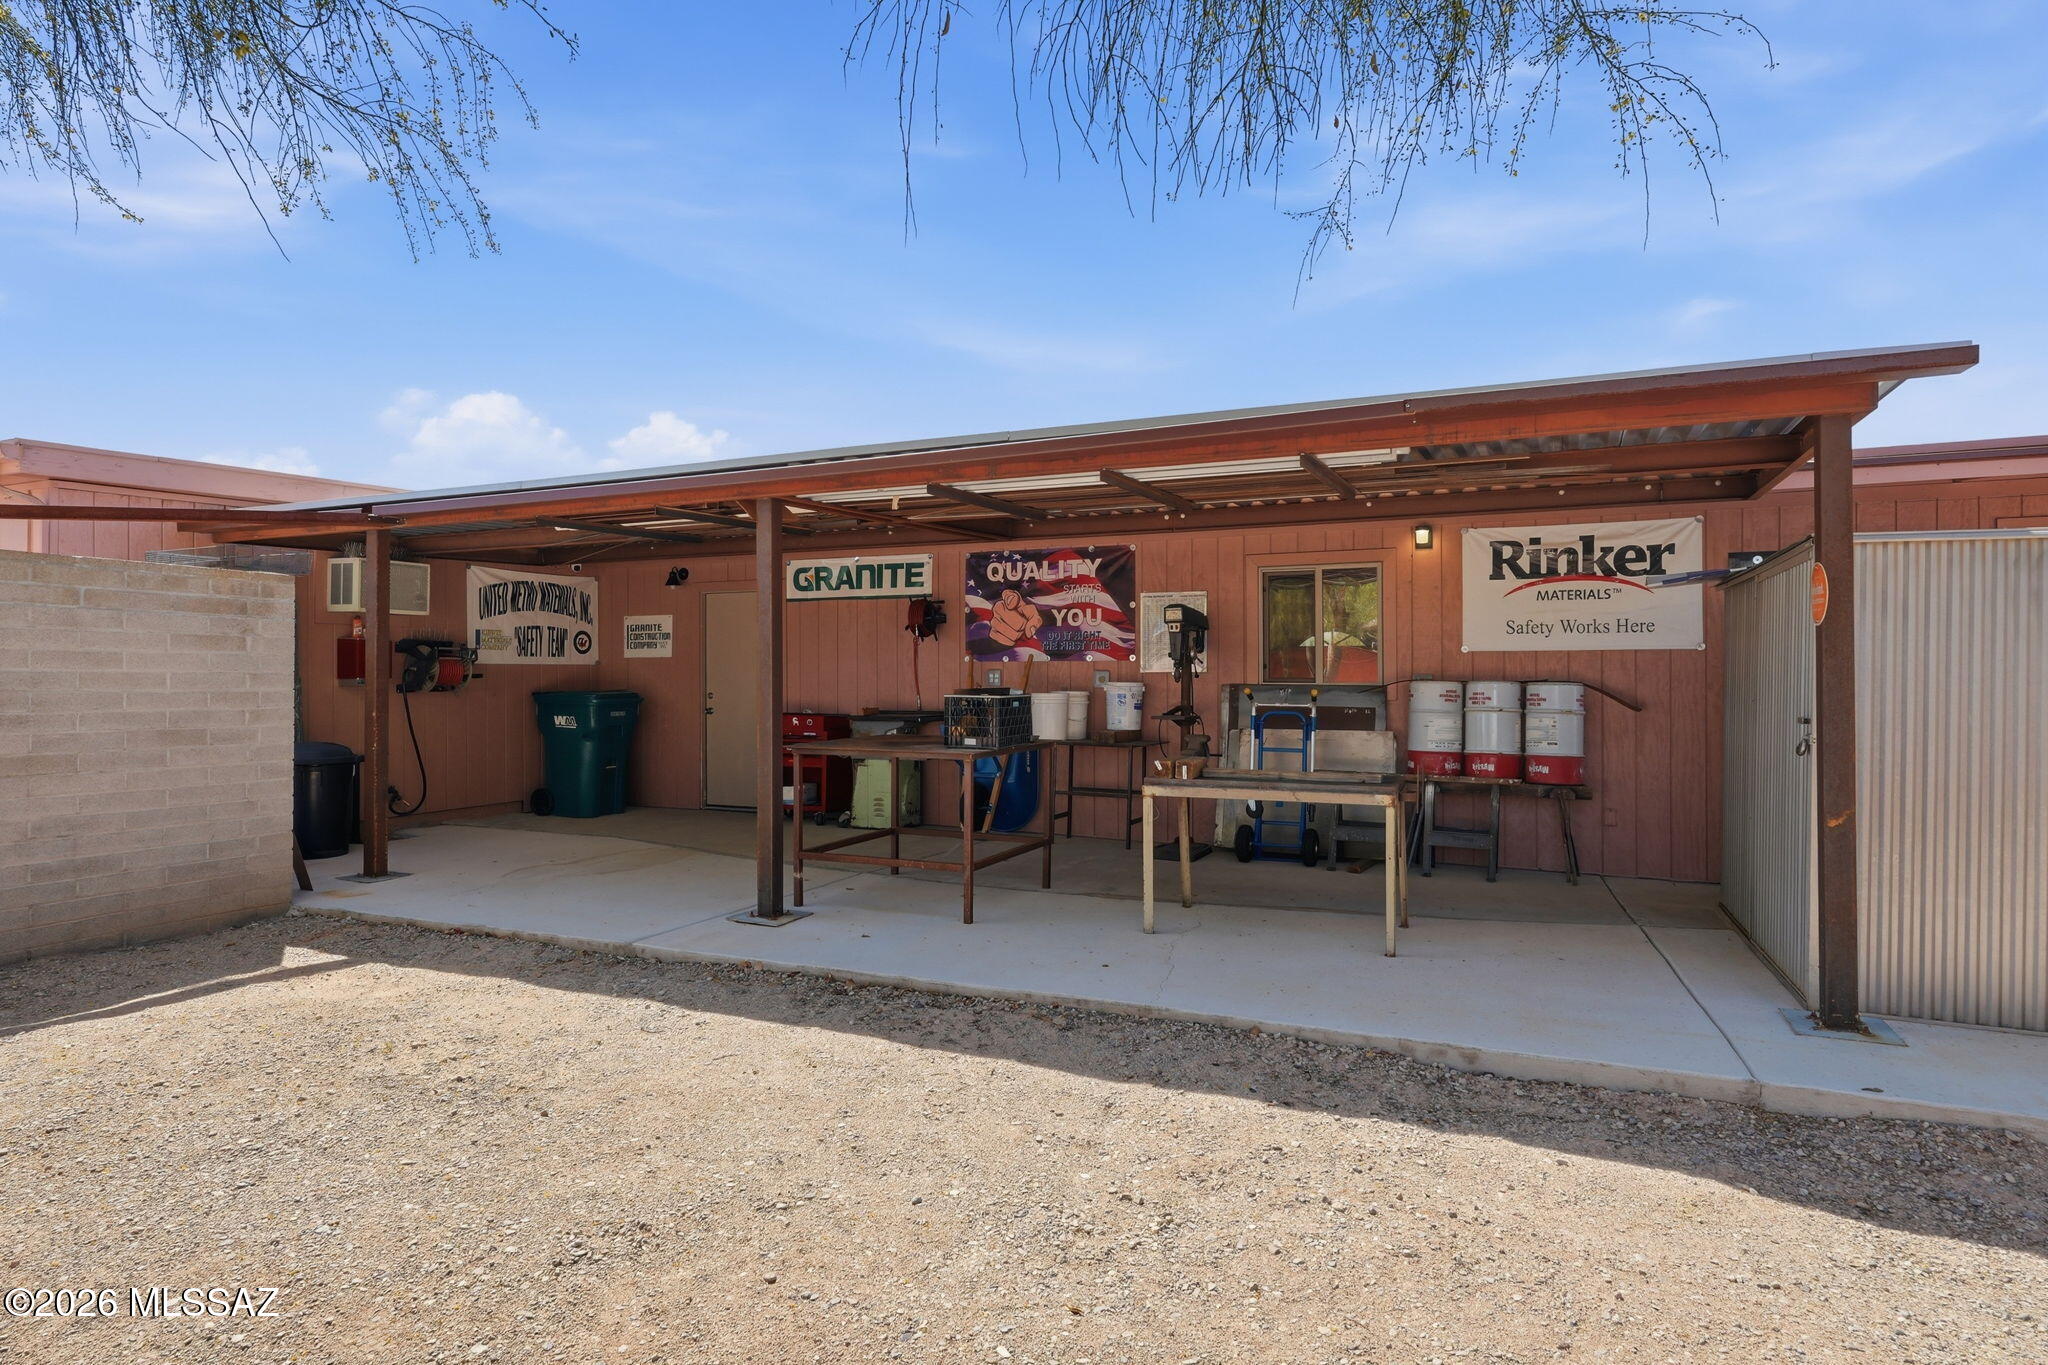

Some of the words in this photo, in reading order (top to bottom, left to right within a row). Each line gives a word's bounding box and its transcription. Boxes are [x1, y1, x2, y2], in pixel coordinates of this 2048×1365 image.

[1489, 535, 1676, 580] Rinker
[793, 562, 925, 592] GRANITE
[987, 558, 1102, 583] QUALITY
[1063, 583, 1102, 593] STARTS
[479, 582, 508, 620] UNITED
[510, 581, 538, 612] METRO
[538, 582, 578, 624] MATERIALS,
[579, 590, 593, 626] INC.
[1051, 608, 1102, 627] YOU
[630, 624, 662, 632] GRANITE
[1048, 631, 1060, 640] DO
[1063, 631, 1071, 640] IT
[1073, 630, 1102, 640] RIGHT
[1506, 619, 1554, 638] Safety
[1560, 618, 1610, 634] Works
[1616, 618, 1655, 633] Here
[630, 632, 671, 640] CONSTRUCTION
[1043, 641, 1057, 650] THE
[1060, 641, 1086, 650] FIRST
[1088, 640, 1111, 650] TIME
[554, 715, 577, 727] WM
